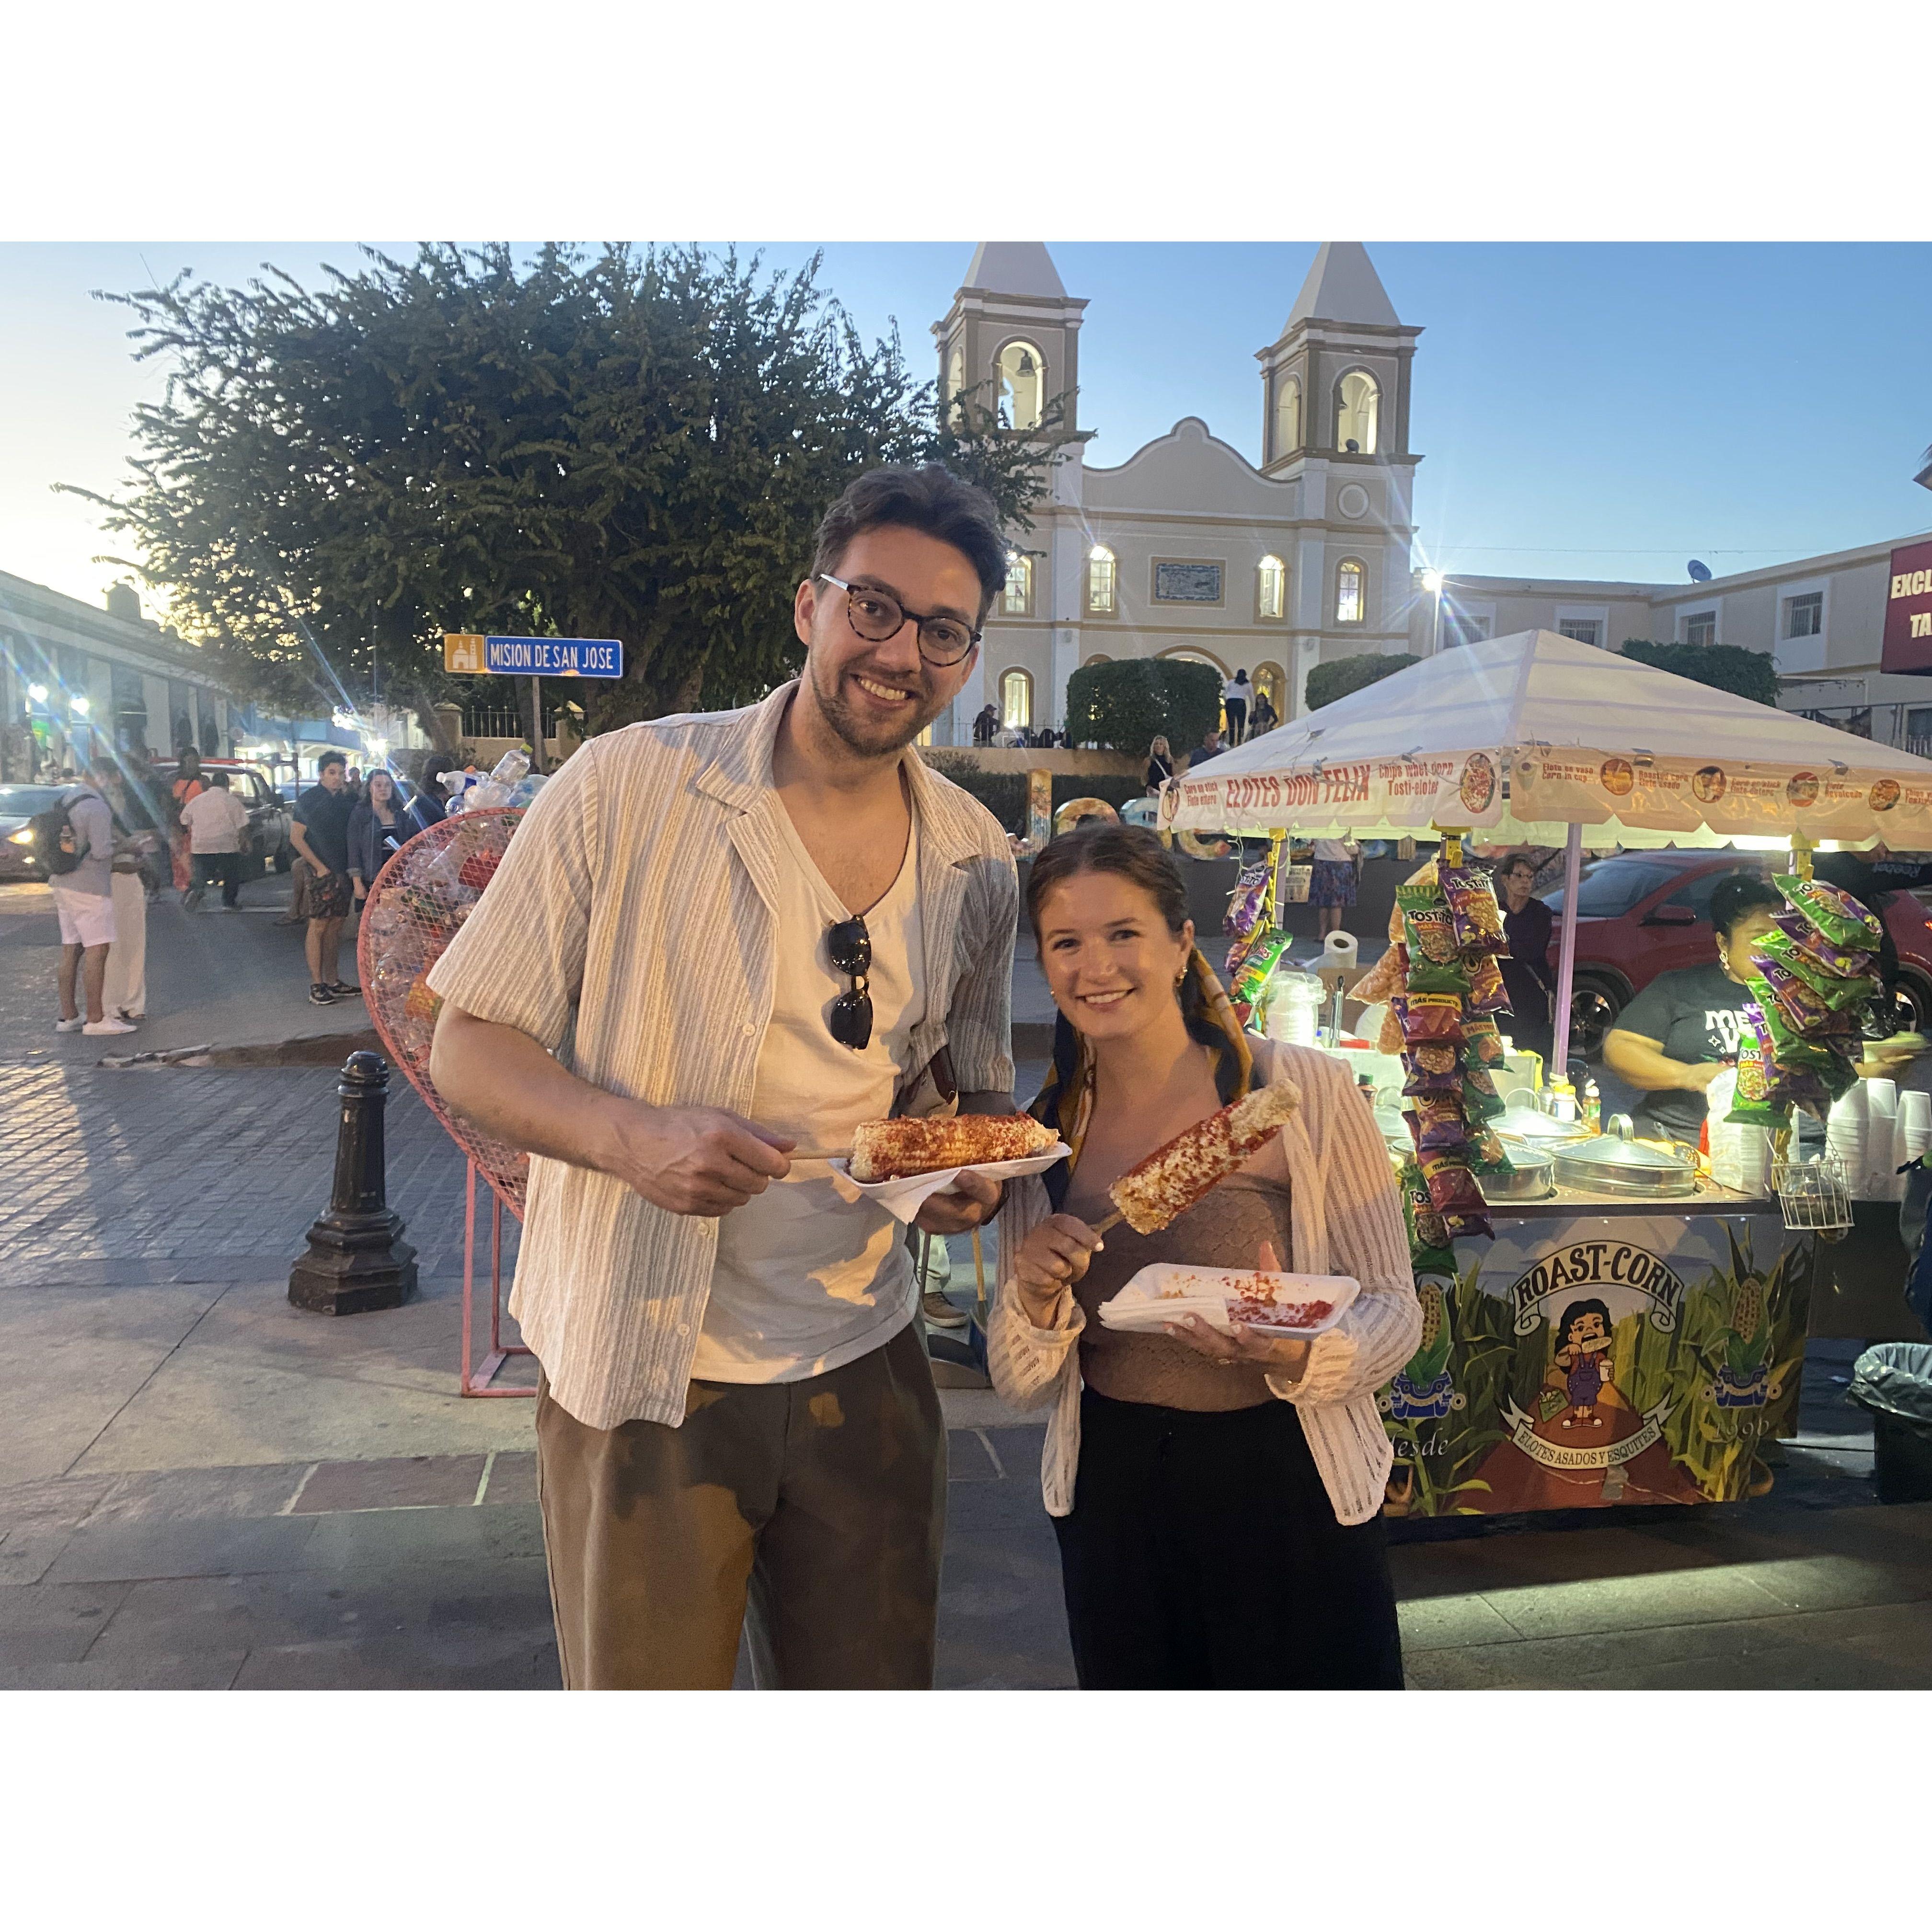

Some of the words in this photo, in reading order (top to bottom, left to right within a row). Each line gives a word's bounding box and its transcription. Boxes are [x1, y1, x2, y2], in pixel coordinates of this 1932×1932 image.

[1891, 569, 1932, 598] EXCL
[491, 643, 531, 667] MISION
[535, 645, 550, 667] DE
[553, 645, 578, 667] SAN
[582, 647, 613, 669] JOSE
[1226, 776, 1281, 808] ELOTES
[1516, 1244, 1679, 1311] ROAST-CORN
[1520, 1430, 1555, 1462] ELOTES
[1554, 1452, 1597, 1465] ASADOS
[1598, 1451, 1606, 1464] Y
[1607, 1427, 1656, 1462] ESQUITES
